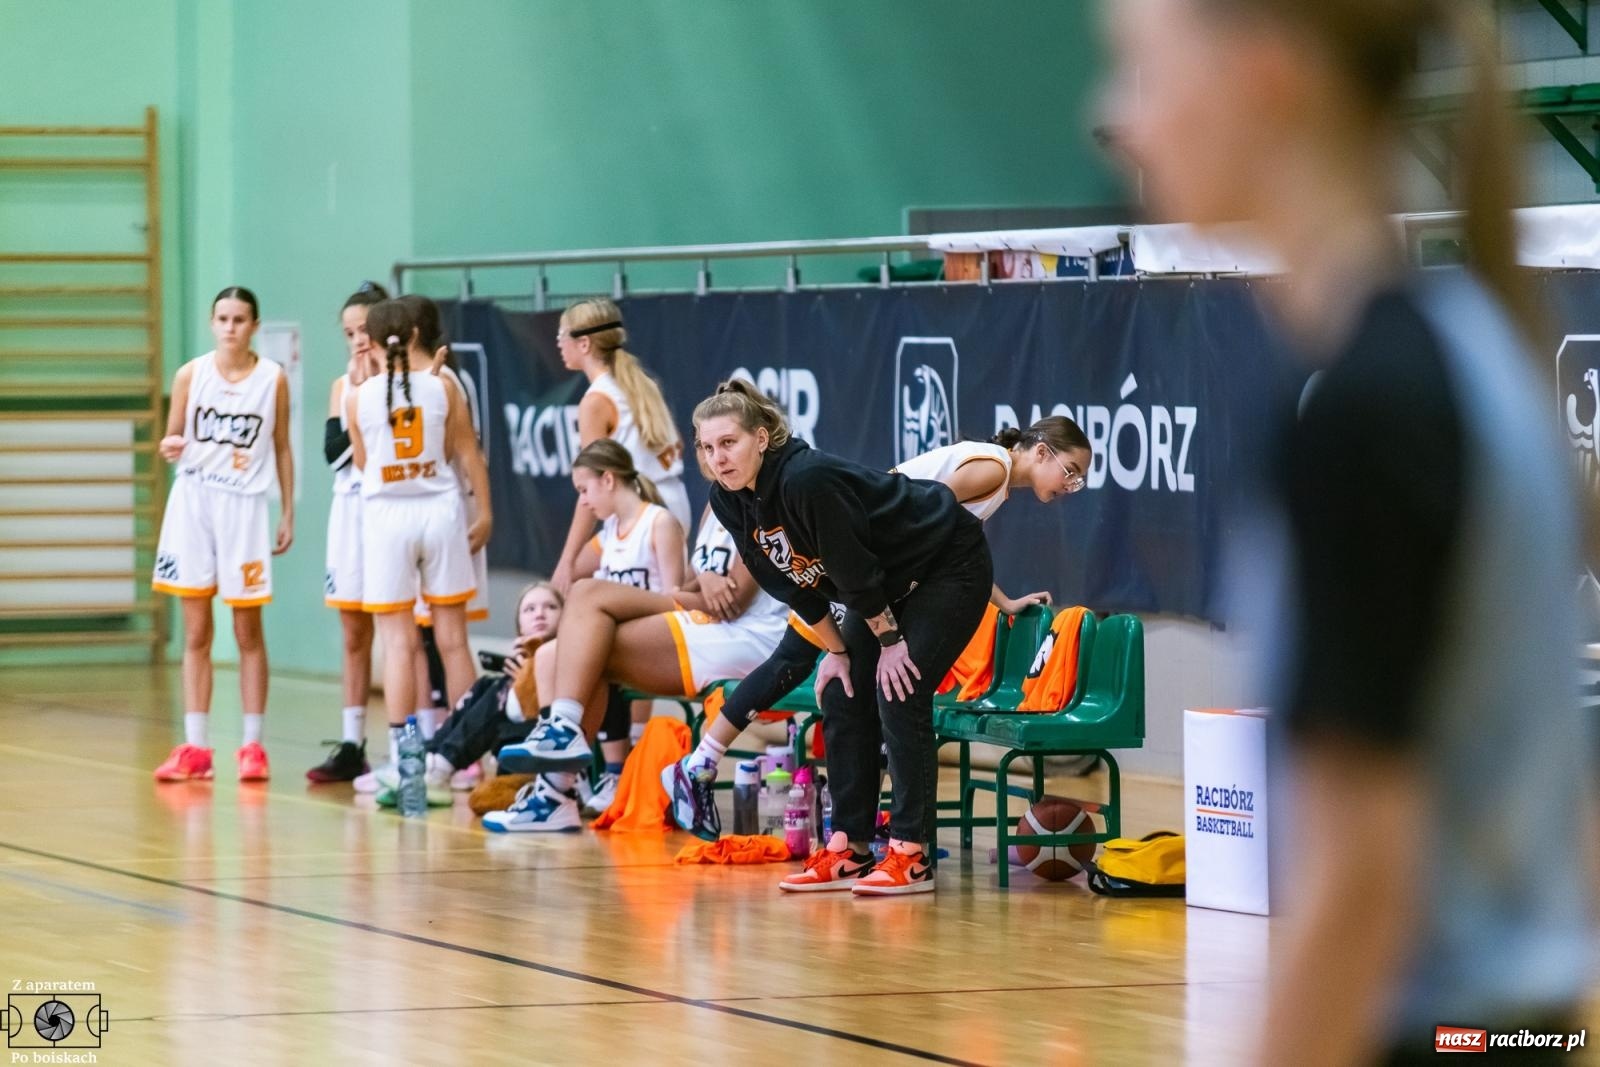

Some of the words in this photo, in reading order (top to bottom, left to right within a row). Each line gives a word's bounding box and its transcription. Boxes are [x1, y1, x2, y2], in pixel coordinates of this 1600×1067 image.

[390, 406, 423, 459] 9
[994, 372, 1197, 492] BÓRZ
[1196, 784, 1254, 811] RACIBÓRZ
[1196, 815, 1254, 838] BASKETBALL
